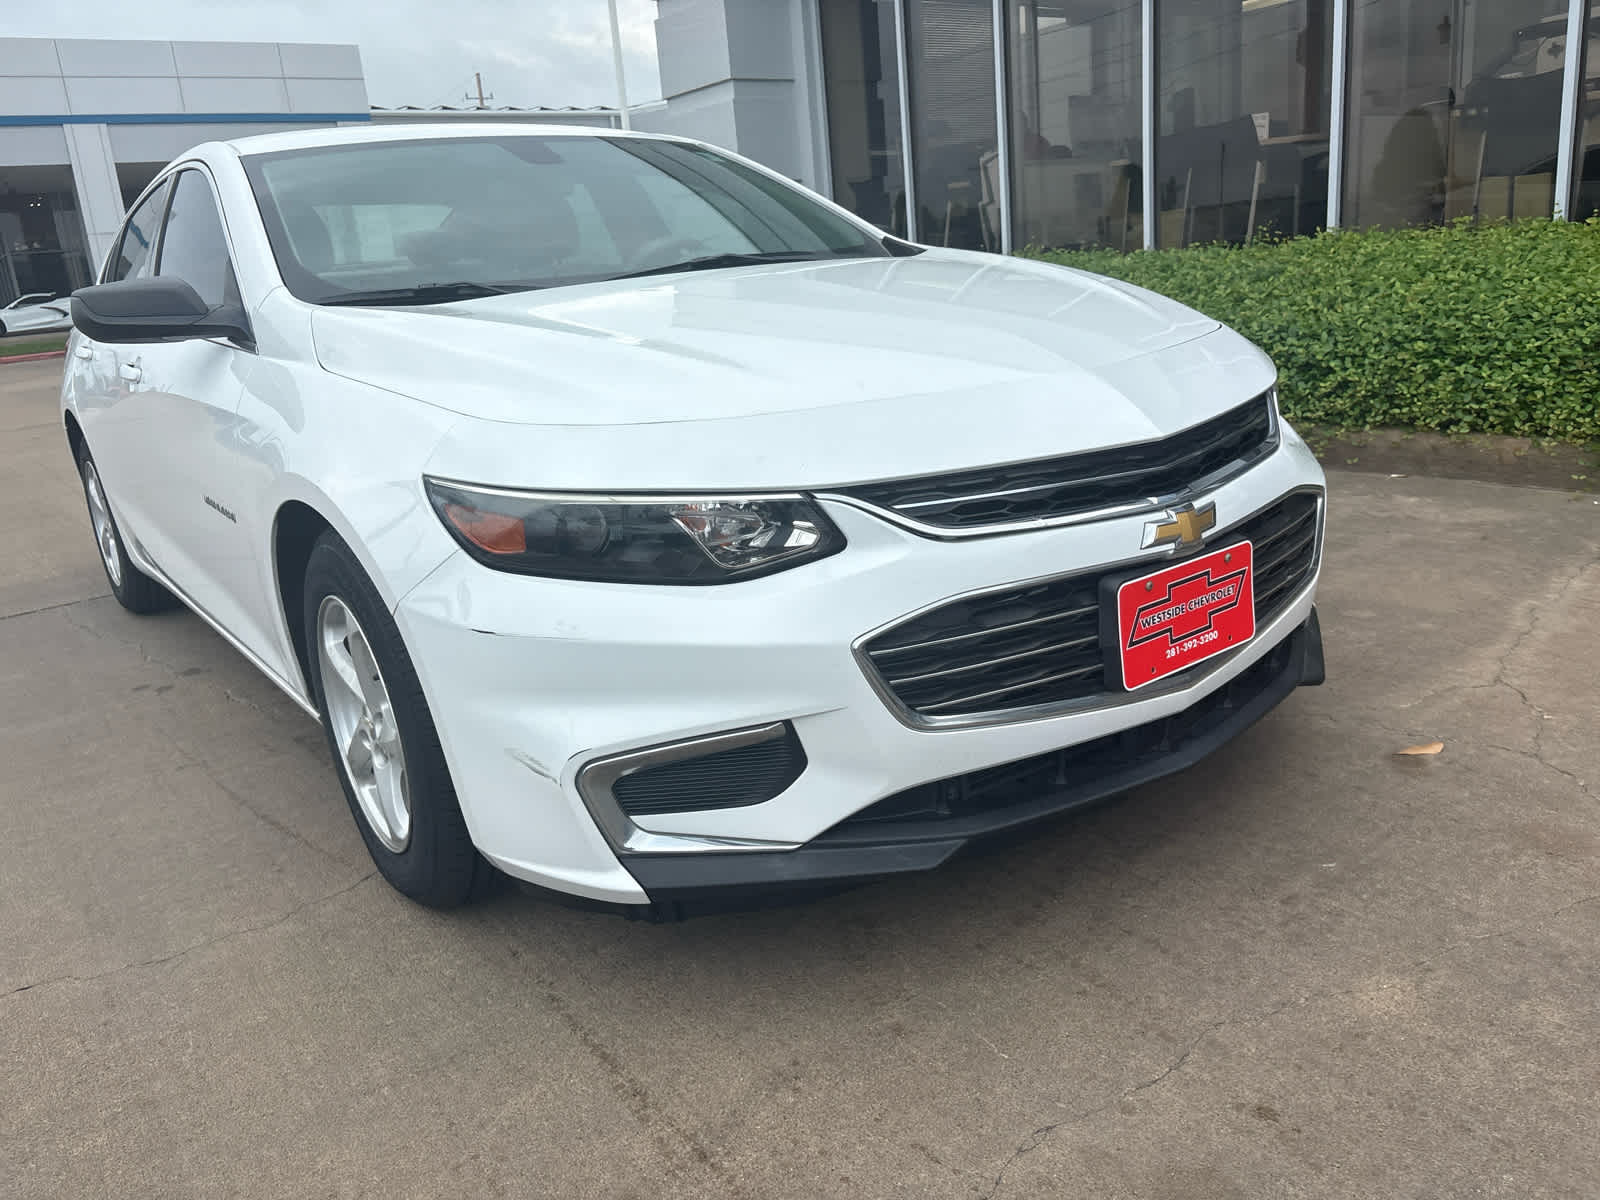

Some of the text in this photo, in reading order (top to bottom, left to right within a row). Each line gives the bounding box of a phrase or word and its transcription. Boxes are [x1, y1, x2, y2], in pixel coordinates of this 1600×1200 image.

[1140, 584, 1236, 629] WESTSIDE CHEVROLET
[1165, 631, 1218, 659] 281-392-3200
